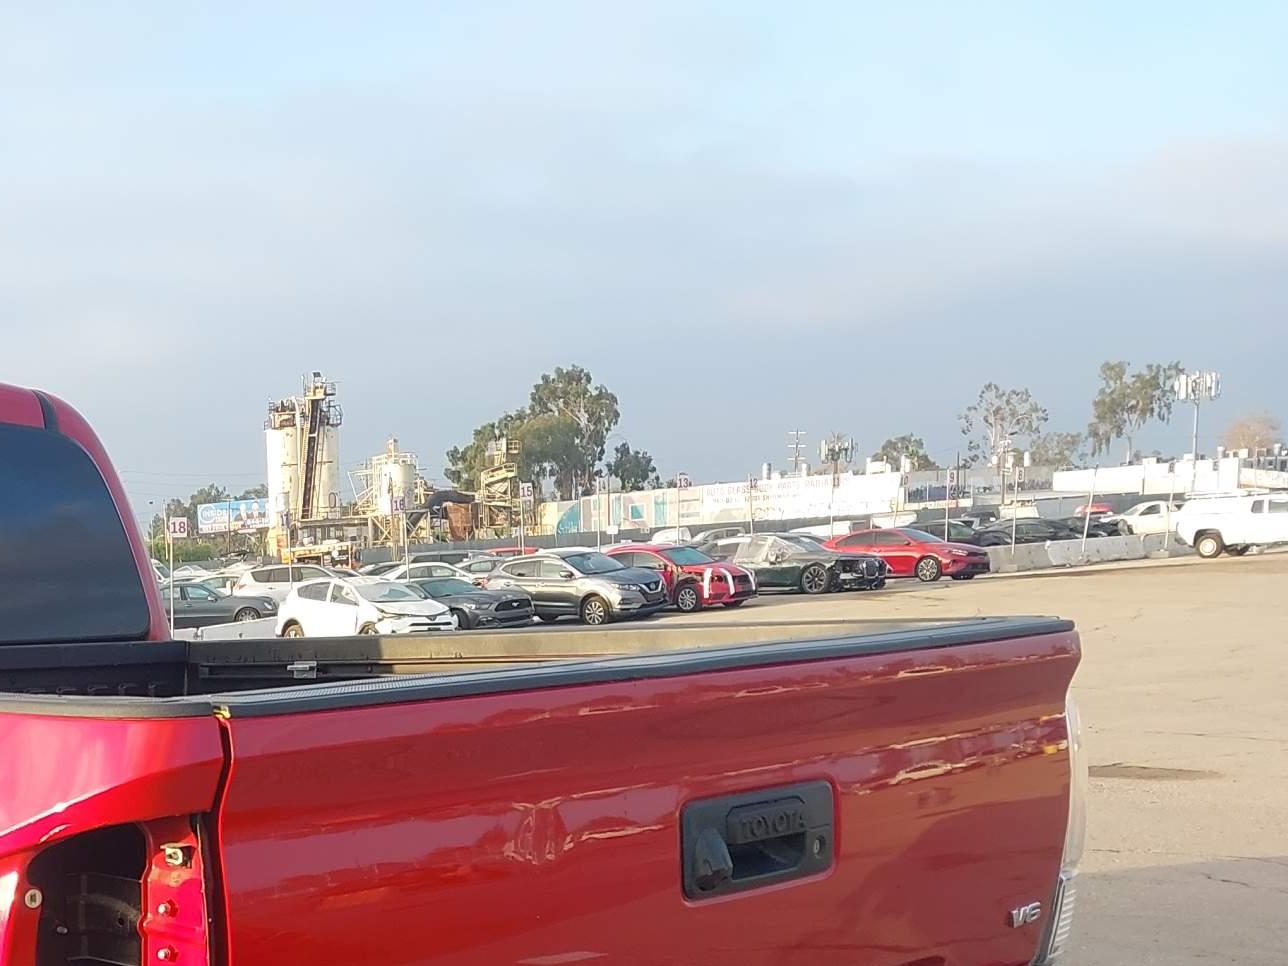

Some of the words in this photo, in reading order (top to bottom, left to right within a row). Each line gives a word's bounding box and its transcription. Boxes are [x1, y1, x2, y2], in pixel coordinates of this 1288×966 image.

[679, 478, 689, 488] 13
[749, 478, 758, 488] 12
[521, 485, 533, 498] 15
[170, 520, 186, 534] 18
[740, 809, 806, 838] TOYOTA
[1010, 901, 1042, 929] V6
